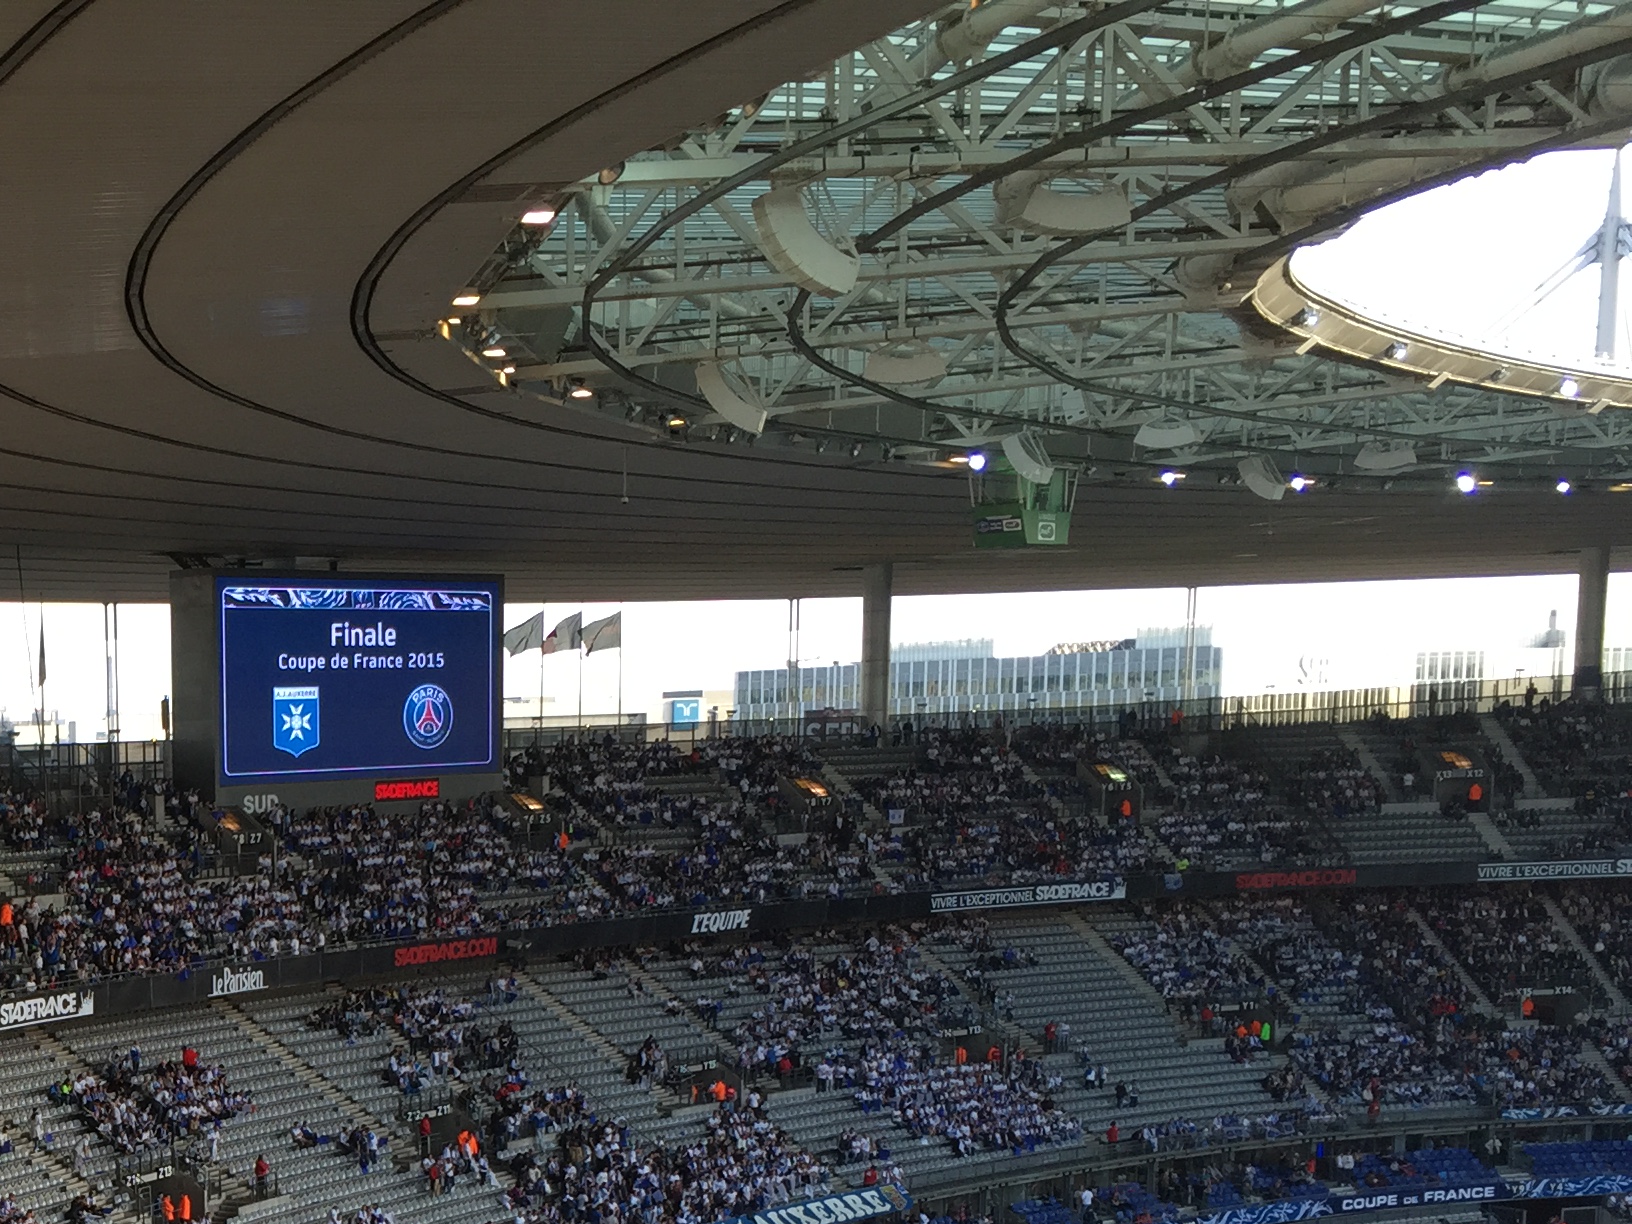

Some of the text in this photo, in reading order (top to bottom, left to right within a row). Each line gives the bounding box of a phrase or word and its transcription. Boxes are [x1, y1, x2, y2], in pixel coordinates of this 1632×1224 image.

[331, 622, 397, 647] Finale
[278, 652, 445, 672] Coupe de France 2015
[412, 687, 445, 704] PARIS
[1466, 769, 1484, 778] X12
[243, 794, 279, 815] SUD
[250, 832, 262, 844] Z7
[1478, 866, 1513, 879] VIVRE
[1516, 862, 1614, 877] L'EXCEPTIONNEL
[931, 895, 958, 909] VIVRE
[958, 889, 1034, 906] L'EXCEPTIONNEL
[223, 966, 264, 991] Parisien
[0, 992, 77, 1026] STADEFRANCE
[158, 1165, 173, 1179] Z13
[1342, 1185, 1496, 1212] COUPE DE FRANCE
